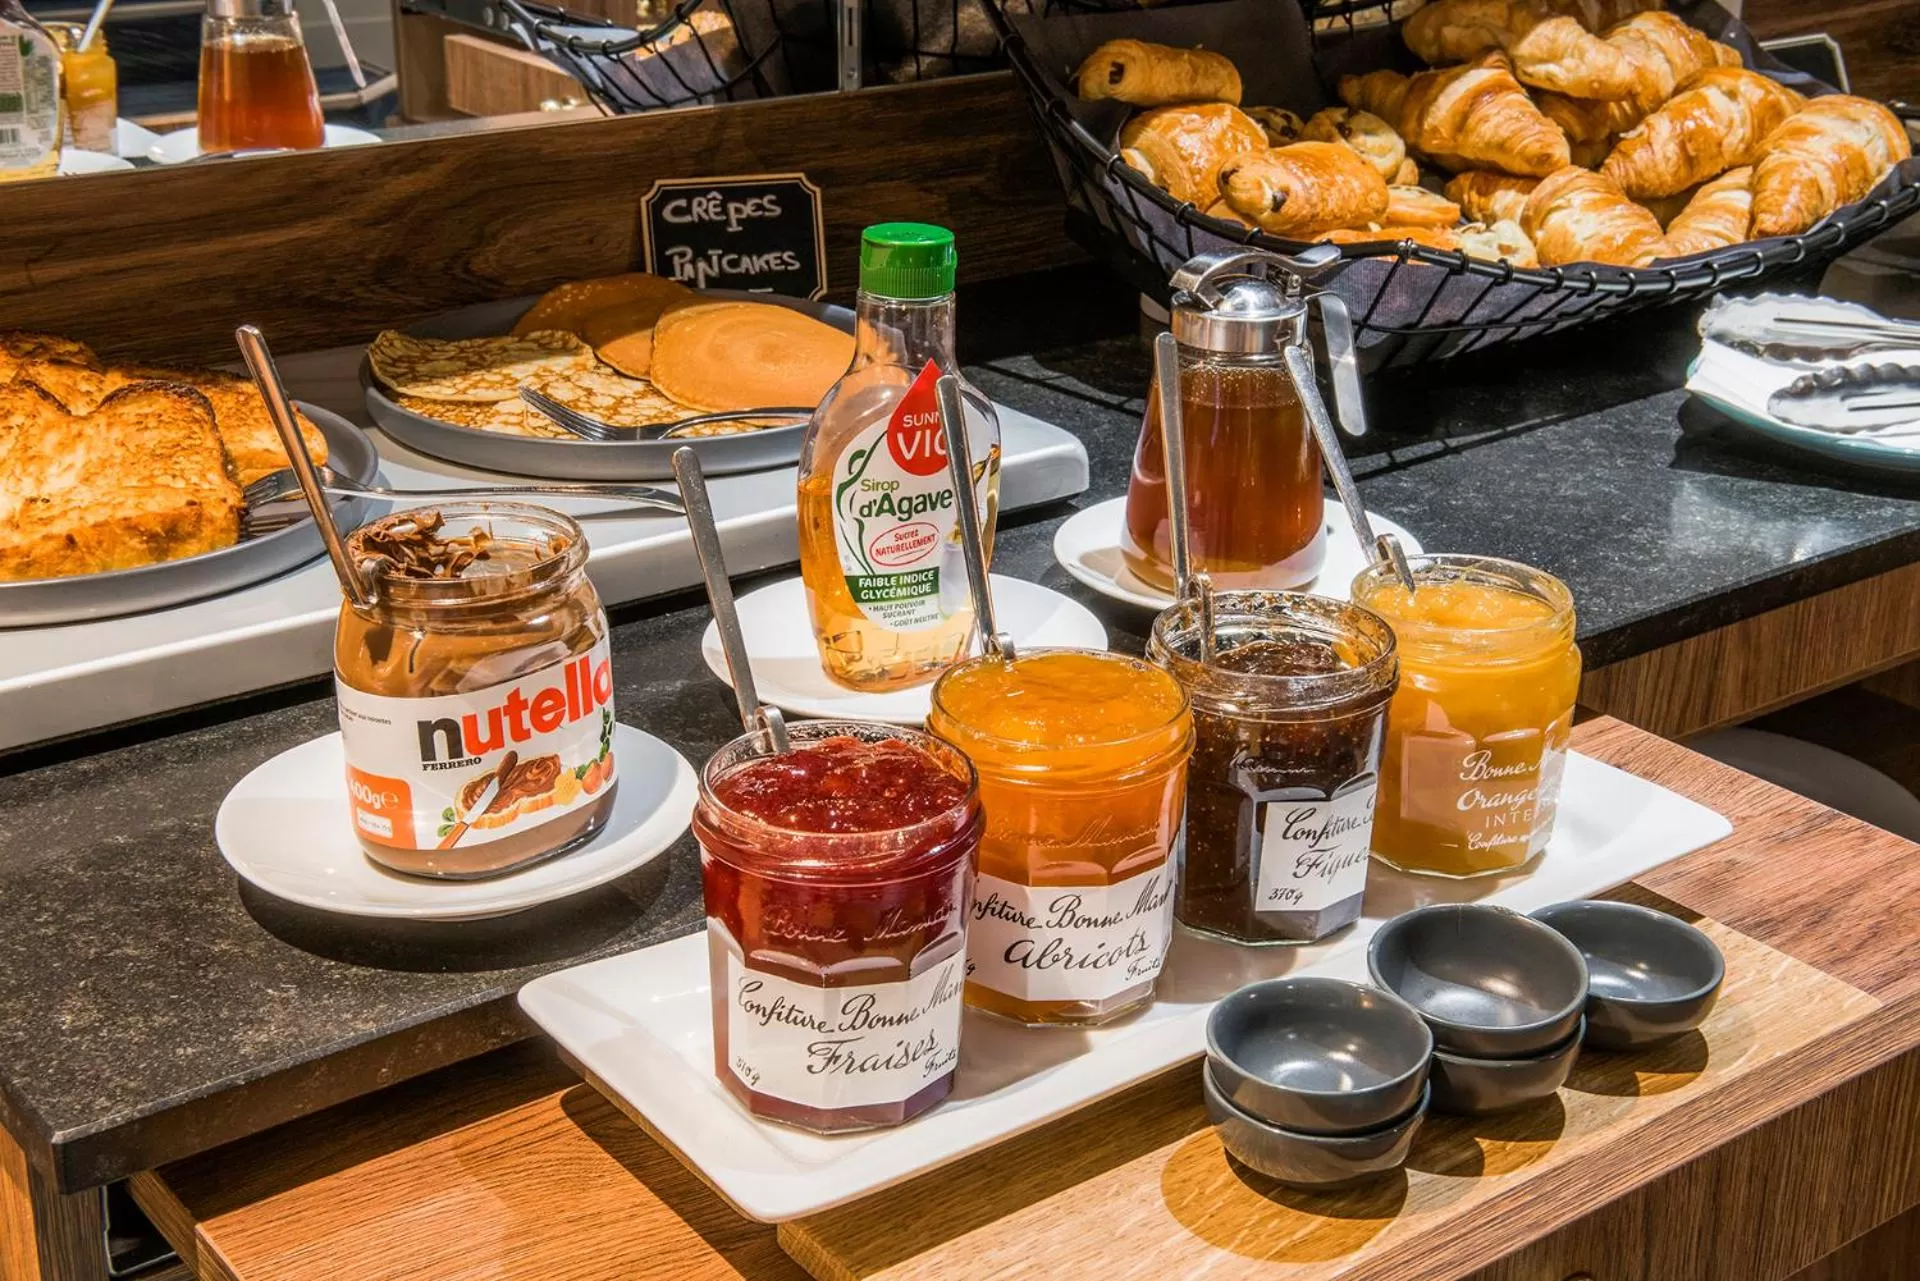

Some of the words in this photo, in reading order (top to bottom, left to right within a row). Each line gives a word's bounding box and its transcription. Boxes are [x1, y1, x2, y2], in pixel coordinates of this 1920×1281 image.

[665, 246, 801, 289] PANCAKES
[860, 478, 900, 493] Sirop
[859, 488, 953, 522] d'Agave
[875, 533, 936, 557] NATURELLEMENT
[858, 576, 898, 588] FAIBLE
[899, 570, 935, 586] INDICE
[860, 582, 933, 600] GLYCÉMIQUE
[422, 756, 483, 771] FERRERO
[1460, 749, 1526, 781] Bonne
[1281, 806, 1361, 849] Confiture
[1268, 886, 1304, 906] 370g
[1045, 894, 1123, 930] Bonne
[737, 975, 834, 1034] Confiture
[837, 993, 921, 1033] Bonne
[806, 1028, 939, 1076] Fraises
[922, 1048, 957, 1079] Fruits
